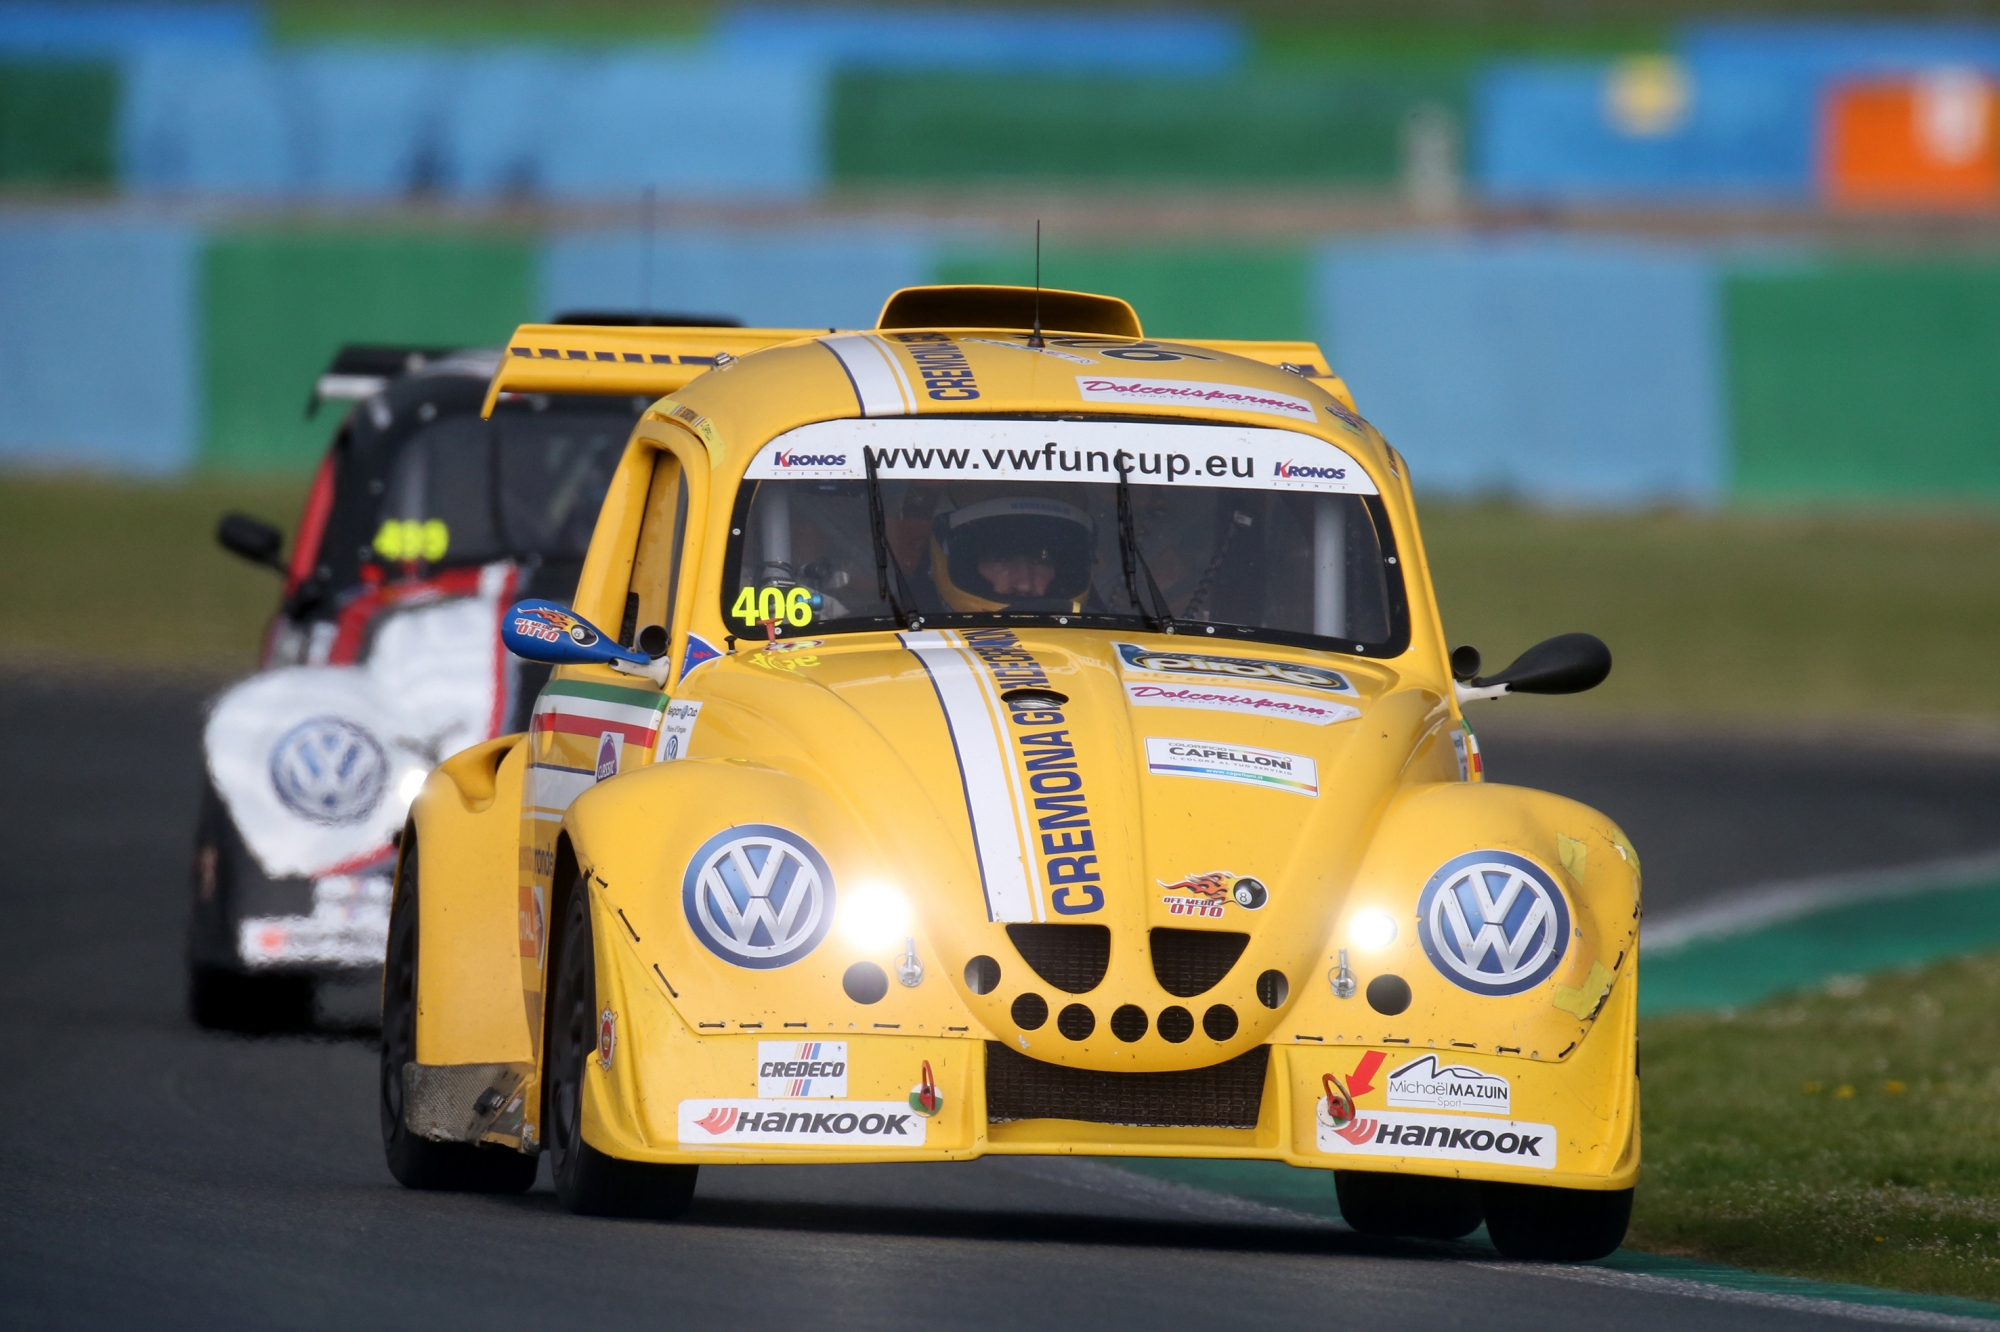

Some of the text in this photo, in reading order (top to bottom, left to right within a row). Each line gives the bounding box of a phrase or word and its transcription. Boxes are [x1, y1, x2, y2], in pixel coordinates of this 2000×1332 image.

[774, 448, 847, 467] KRONOS
[869, 442, 1255, 482] www.vwfuncup.eu
[1274, 458, 1346, 479] KRONOS
[731, 586, 813, 627] 406
[517, 624, 558, 642] OTTO
[1168, 742, 1228, 751] COLORIFICIO
[1169, 747, 1292, 771] CAPELLONI
[1253, 765, 1293, 776] SERVIZIO
[1018, 729, 1105, 917] CREMONA
[1170, 903, 1223, 918] OTTO
[760, 1061, 845, 1078] CREDECO
[1437, 1096, 1462, 1109] Sport
[736, 1111, 913, 1135] HANKOOK
[1376, 1122, 1543, 1157] HANKOOK
